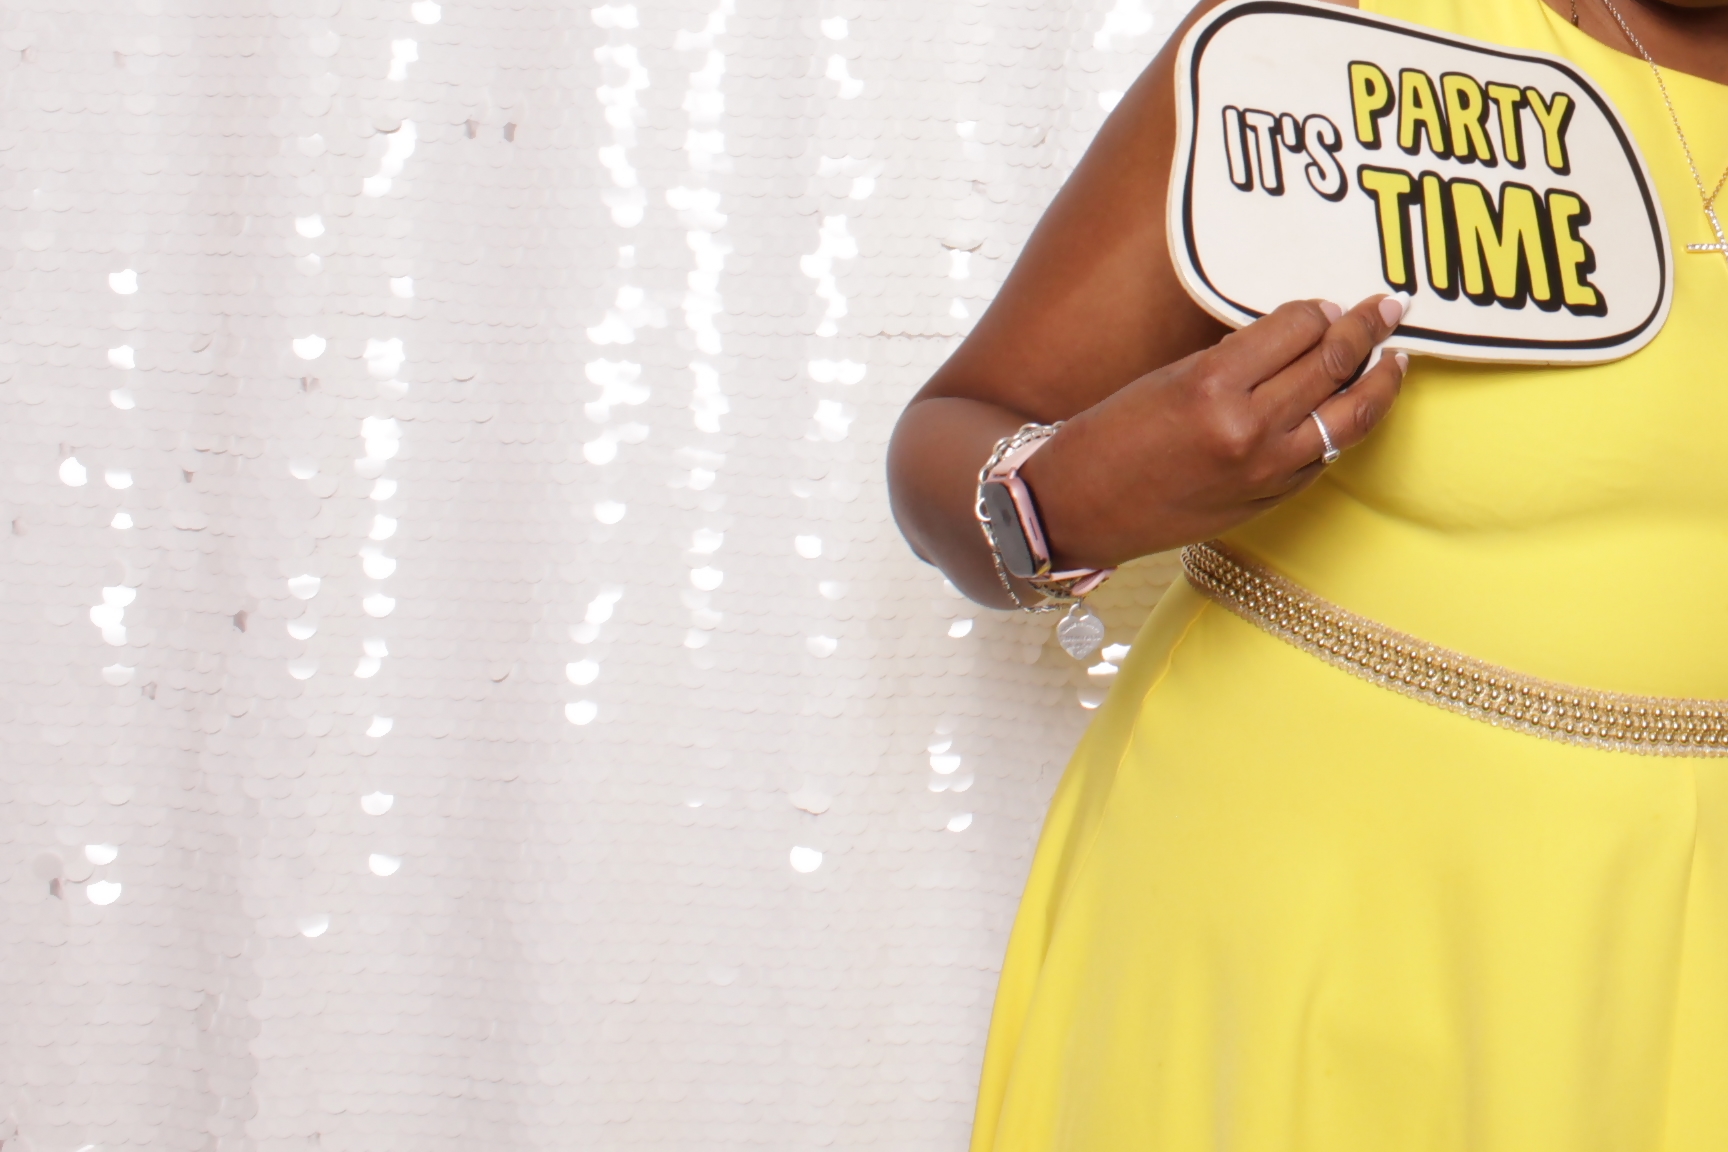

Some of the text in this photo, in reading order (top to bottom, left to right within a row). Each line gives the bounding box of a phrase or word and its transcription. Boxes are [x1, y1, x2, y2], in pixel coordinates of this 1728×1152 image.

[1222, 106, 1348, 201] IT'S
[1347, 60, 1575, 175] PARTY
[1357, 164, 1608, 317] TIME
